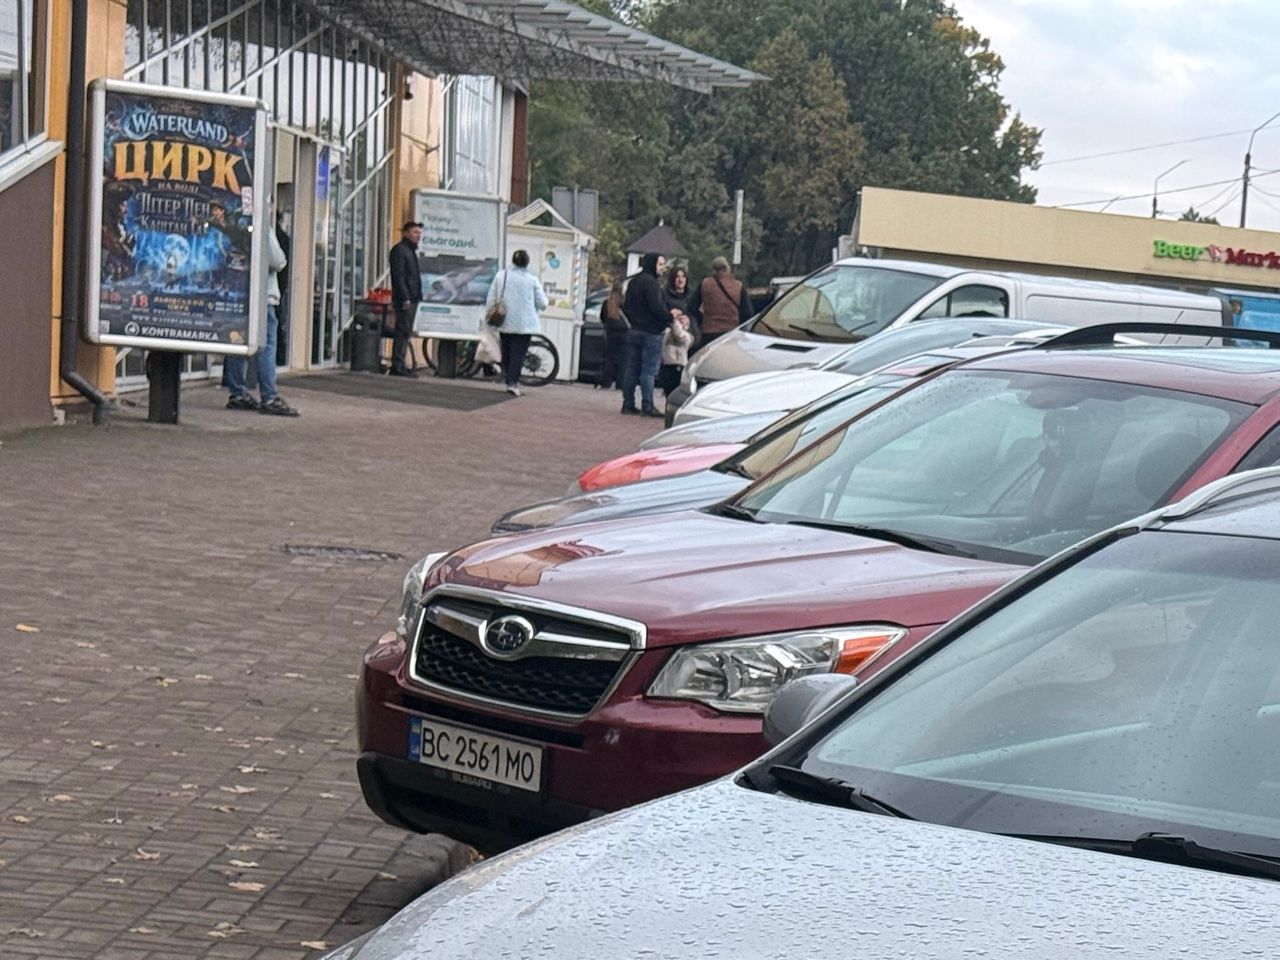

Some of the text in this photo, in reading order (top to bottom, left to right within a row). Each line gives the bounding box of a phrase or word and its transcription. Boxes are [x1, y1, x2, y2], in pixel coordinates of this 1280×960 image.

[124, 113, 229, 143] WATERLAND
[114, 140, 243, 196] ЦИРК
[1153, 239, 1207, 262] Beer
[141, 326, 219, 341] KONTRAMARKA
[422, 727, 534, 783] BC 2561 MO
